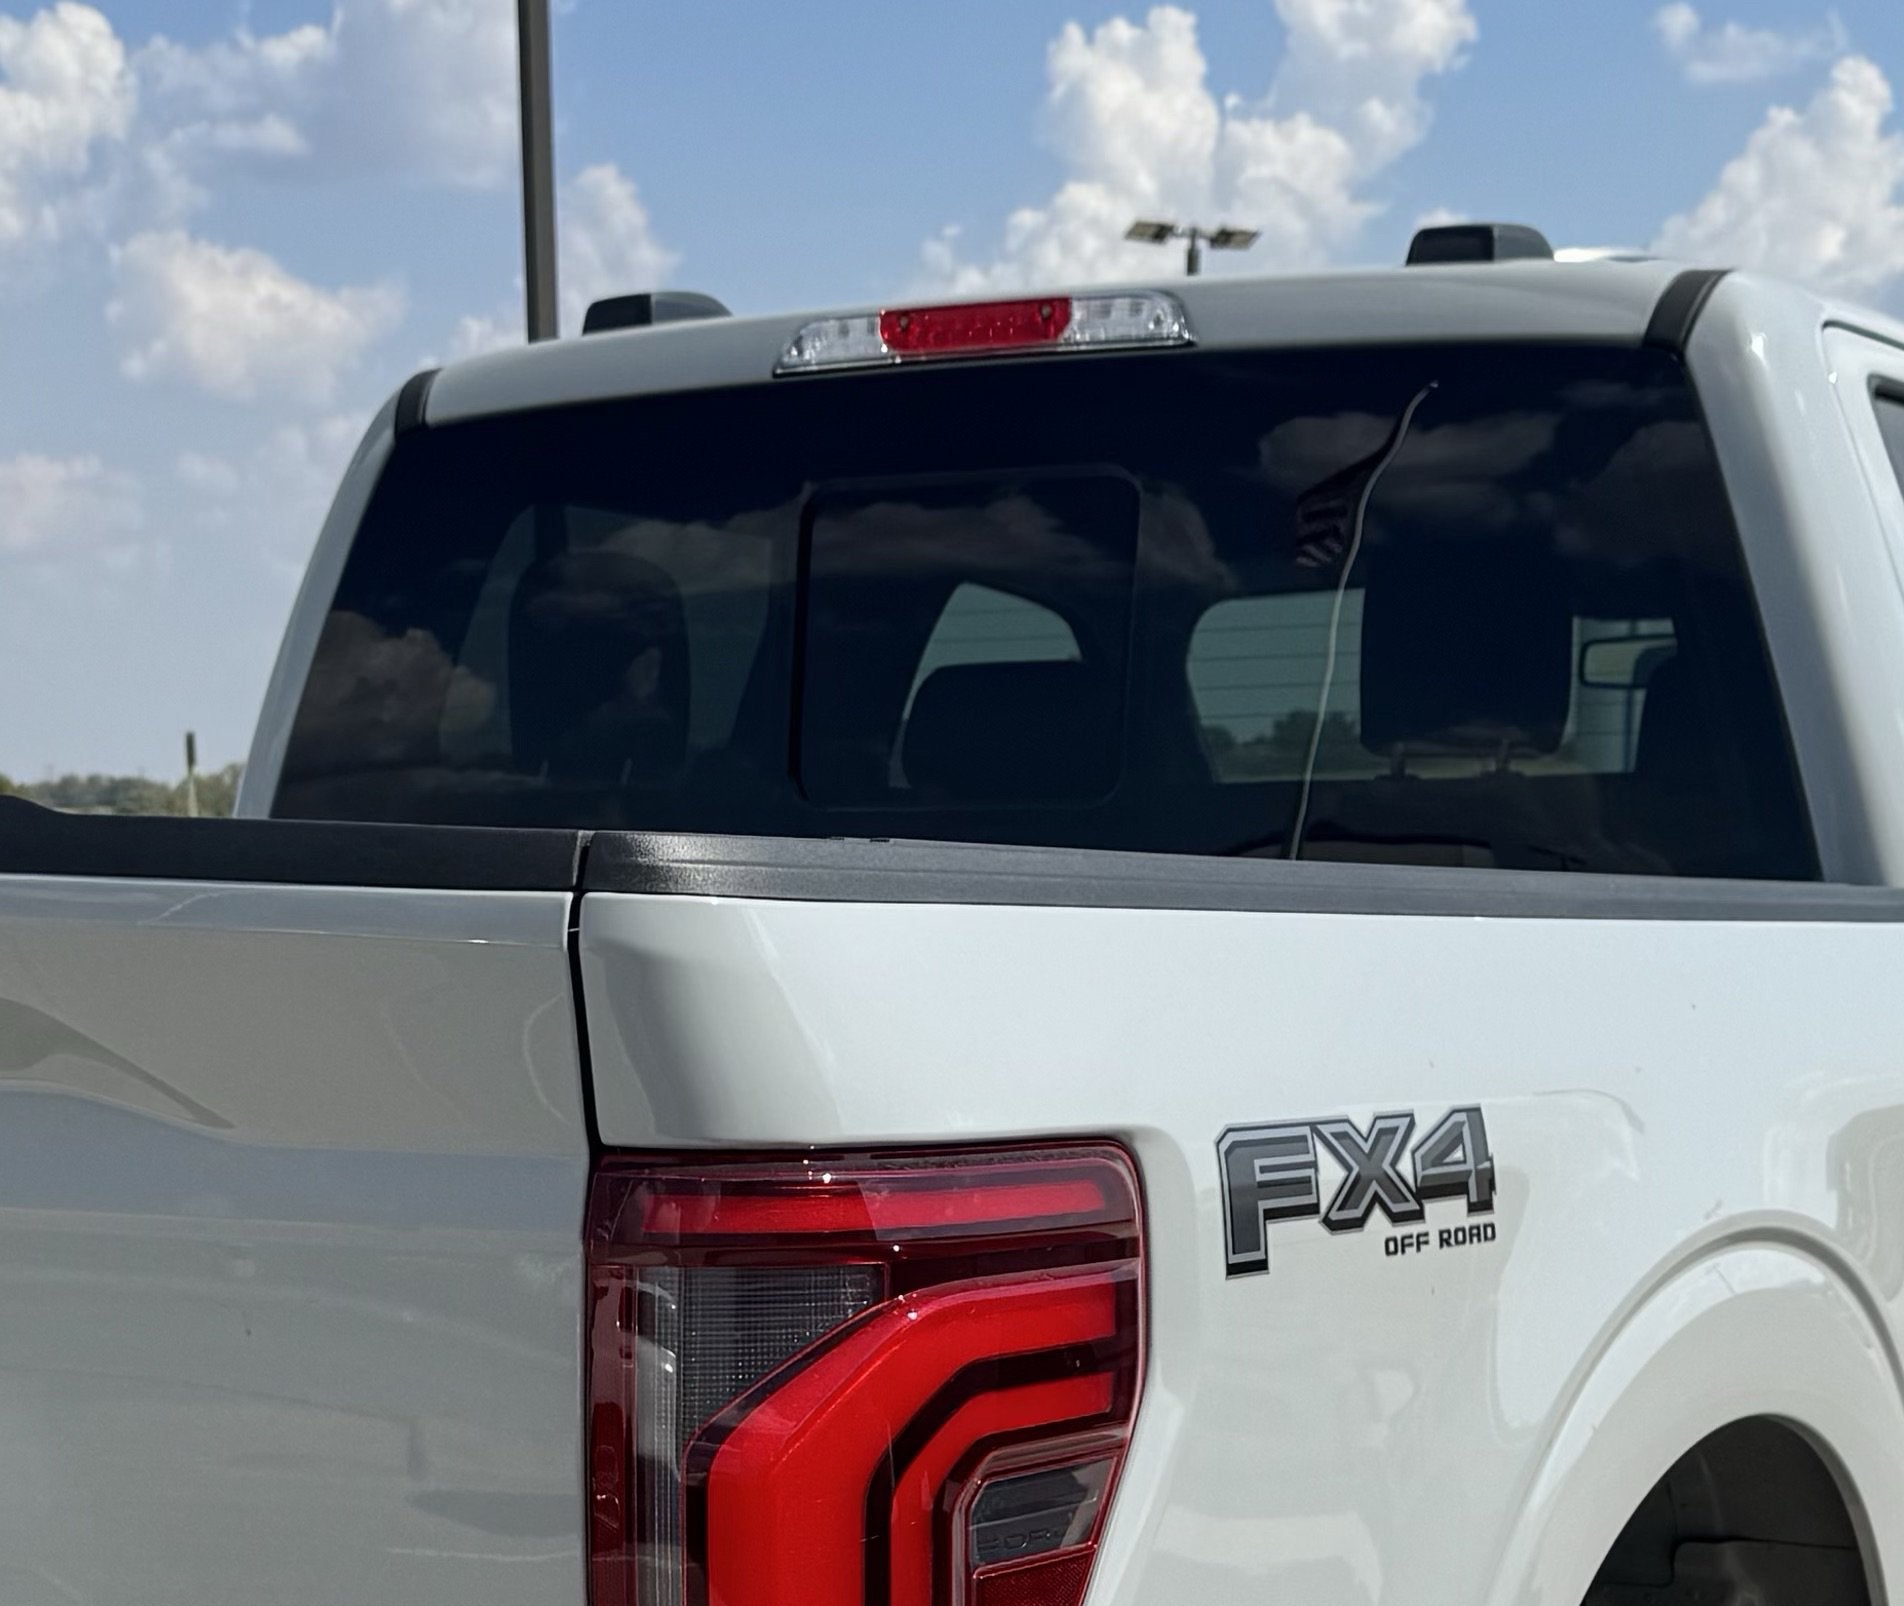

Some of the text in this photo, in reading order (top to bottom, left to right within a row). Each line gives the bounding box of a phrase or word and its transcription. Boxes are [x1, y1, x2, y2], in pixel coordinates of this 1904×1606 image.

[1214, 1103, 1496, 1280] FX4
[1384, 1222, 1496, 1256] OFF ROAD
